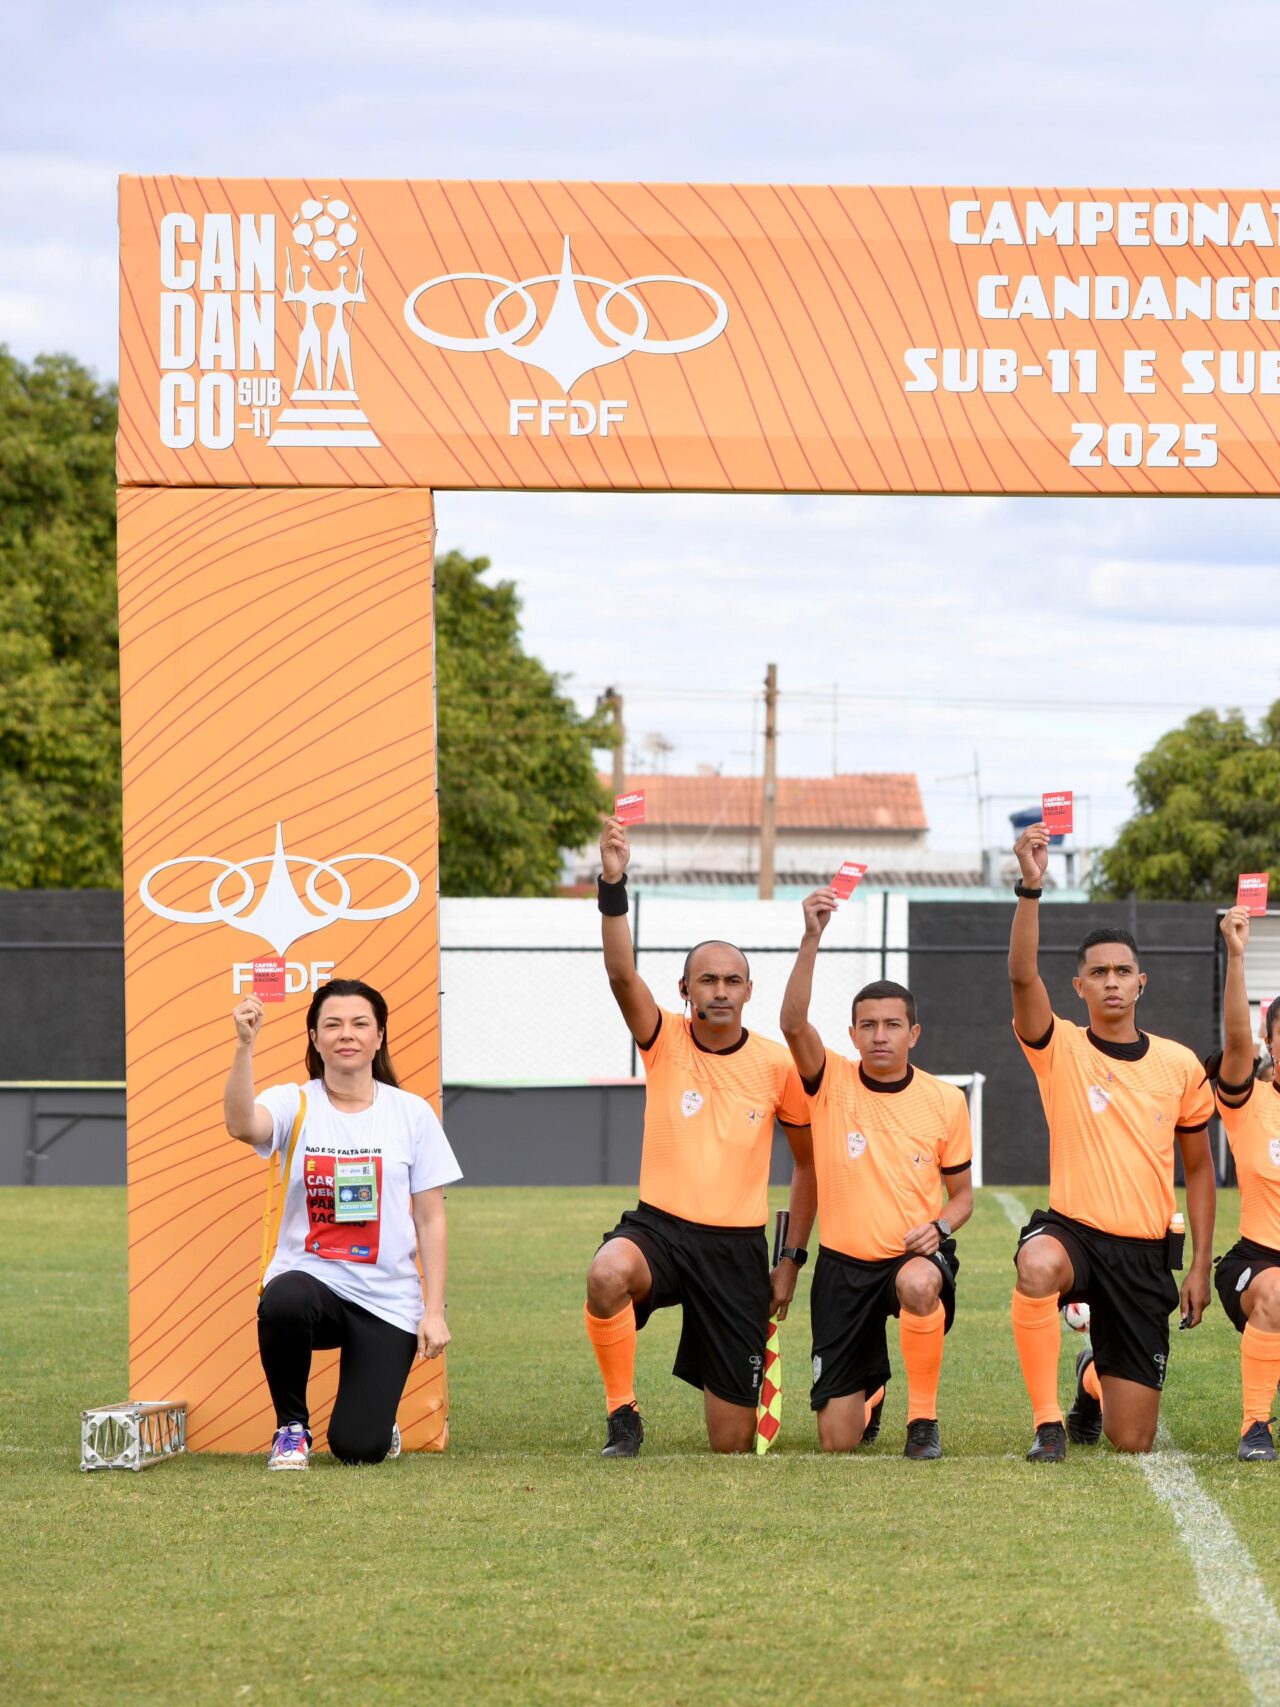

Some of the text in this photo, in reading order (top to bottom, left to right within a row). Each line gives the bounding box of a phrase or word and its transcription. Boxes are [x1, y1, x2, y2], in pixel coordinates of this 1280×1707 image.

[159, 212, 276, 292] CAN
[159, 292, 276, 371] DAN
[237, 377, 281, 406] SUB
[903, 348, 1098, 394] SUB-11
[1123, 349, 1158, 394] E
[159, 372, 236, 450] GO
[238, 408, 272, 438] -11
[509, 399, 629, 437] FFDF
[1069, 422, 1219, 467] 2025
[232, 961, 335, 994] FDF
